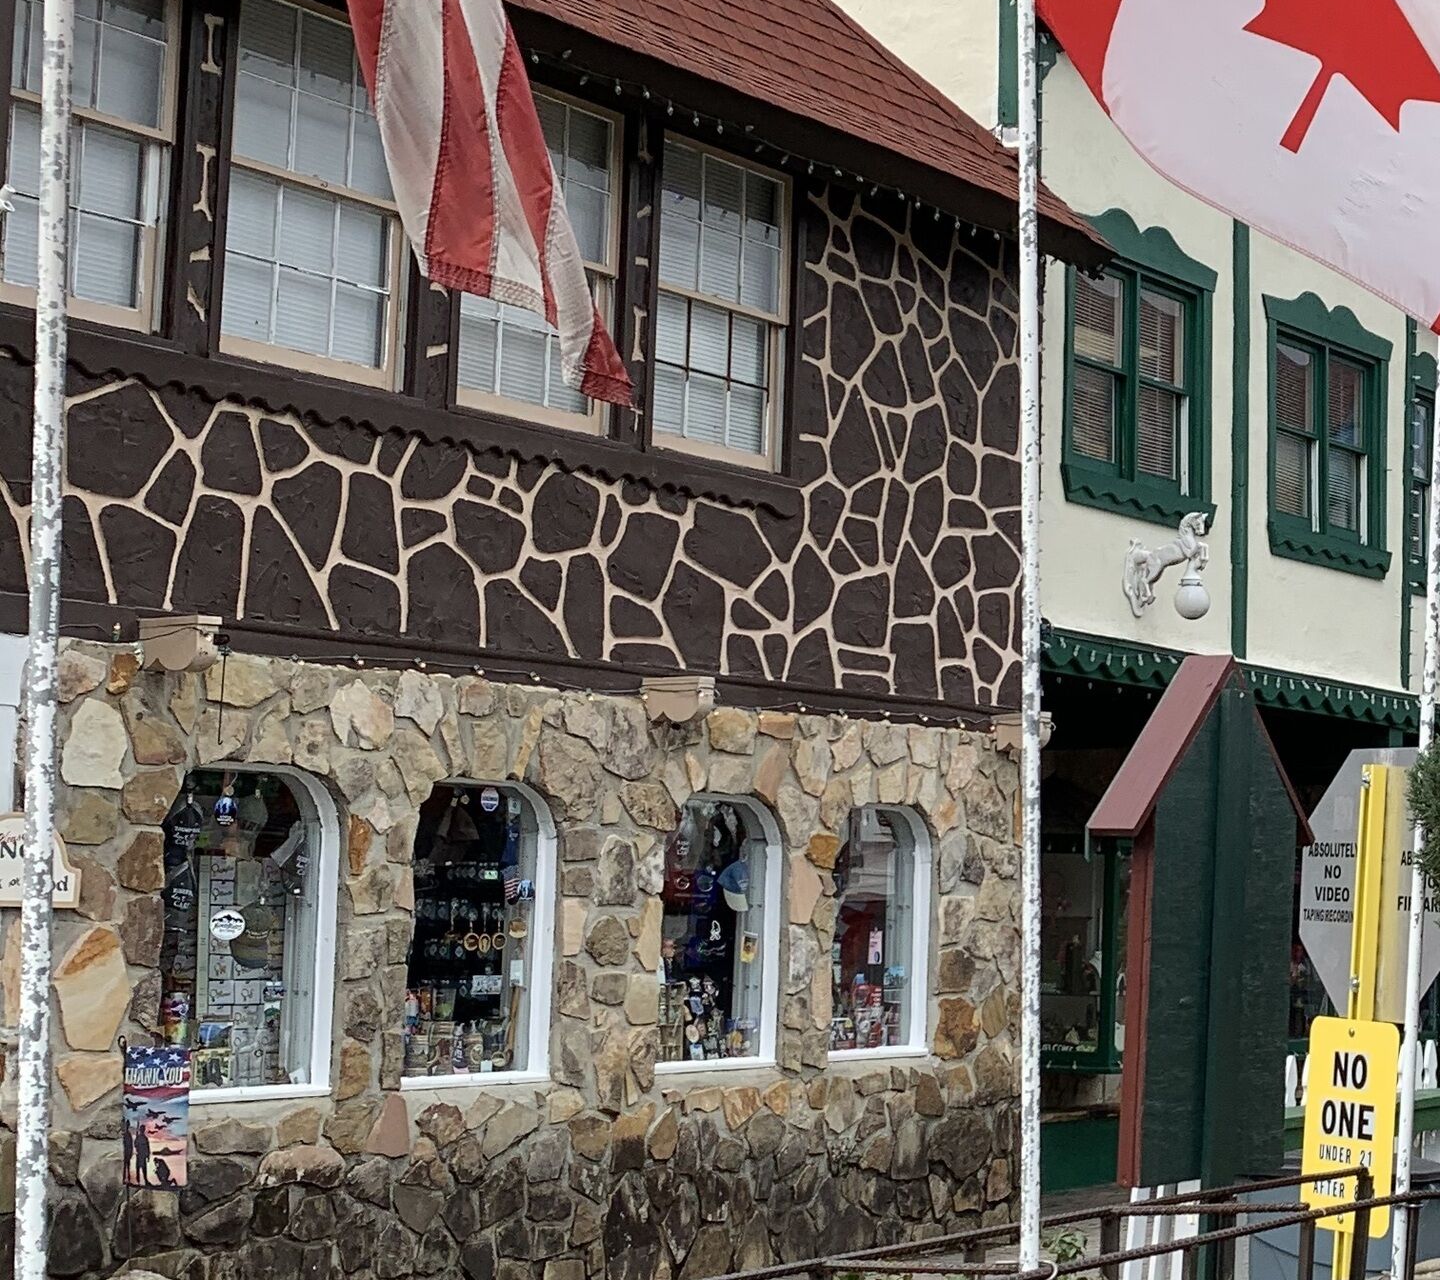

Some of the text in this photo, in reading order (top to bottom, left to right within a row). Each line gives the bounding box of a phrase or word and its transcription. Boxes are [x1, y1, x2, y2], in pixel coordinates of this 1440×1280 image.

[1323, 864, 1342, 879] NO
[1314, 886, 1350, 902] VIDEO
[1303, 908, 1325, 922] TAPING
[125, 1066, 183, 1085] THANK YOU
[1333, 1051, 1368, 1090] NO
[1321, 1100, 1375, 1141] ONE
[1319, 1144, 1372, 1167] UNDER 21
[1313, 1179, 1345, 1198] AFTER
